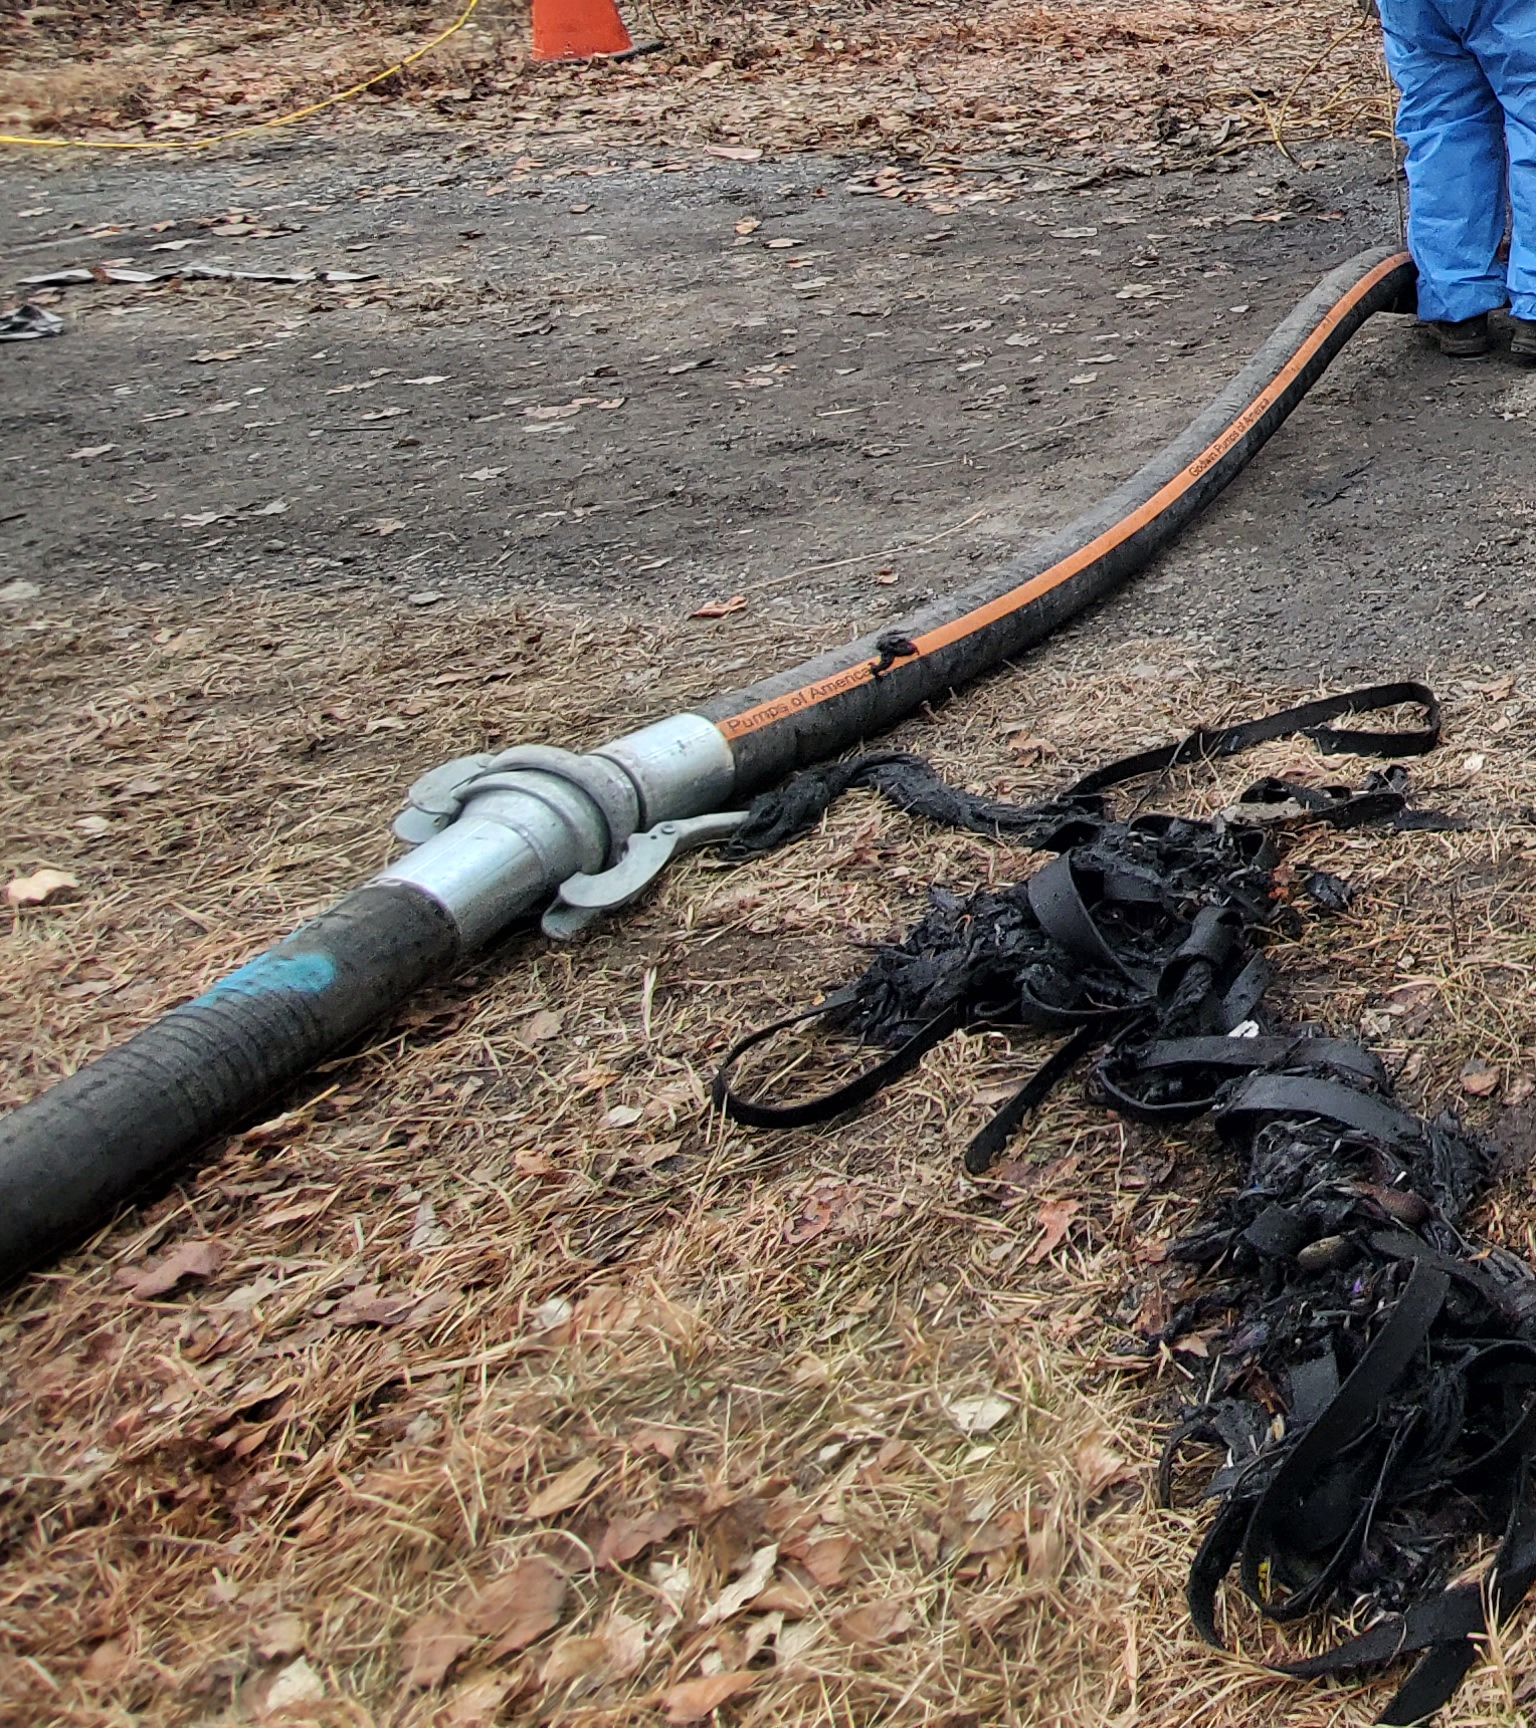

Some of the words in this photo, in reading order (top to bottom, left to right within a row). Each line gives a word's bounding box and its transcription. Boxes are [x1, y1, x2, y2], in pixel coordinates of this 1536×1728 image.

[727, 702, 789, 731] Pumps
[791, 691, 808, 707] of
[810, 667, 872, 699] America
